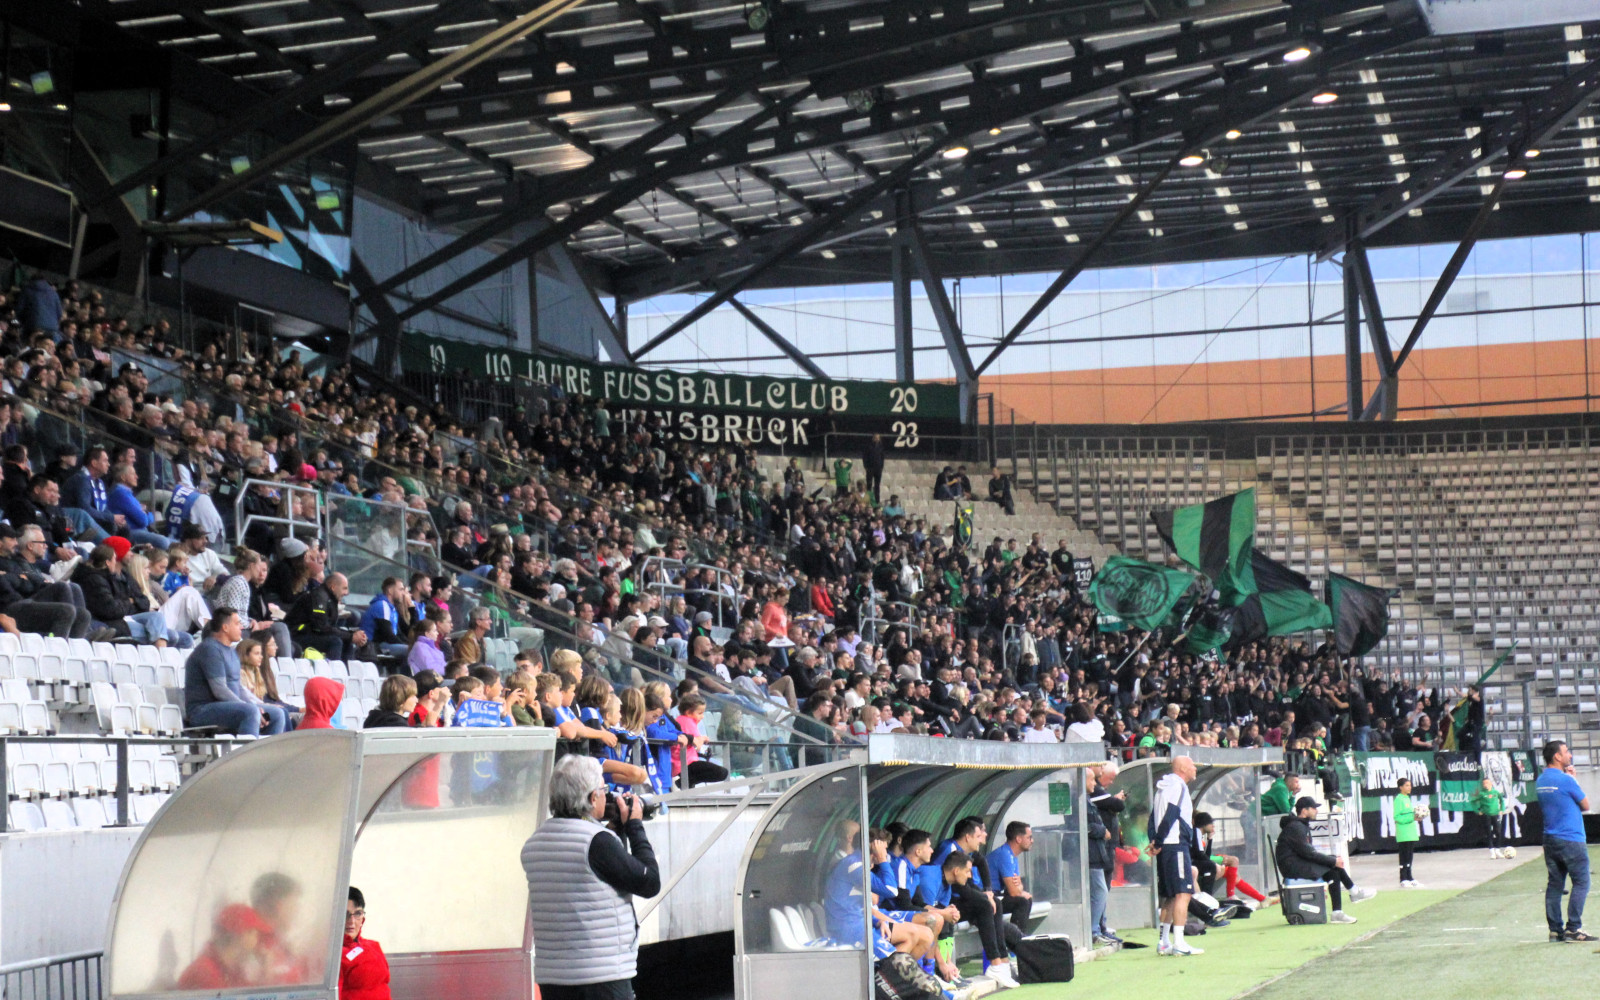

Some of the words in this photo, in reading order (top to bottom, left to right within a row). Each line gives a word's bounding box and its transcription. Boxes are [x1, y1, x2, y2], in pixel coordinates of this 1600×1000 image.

[603, 370, 849, 412] FUSSBALLCLUB
[889, 387, 918, 412] 20
[891, 421, 920, 448] 23
